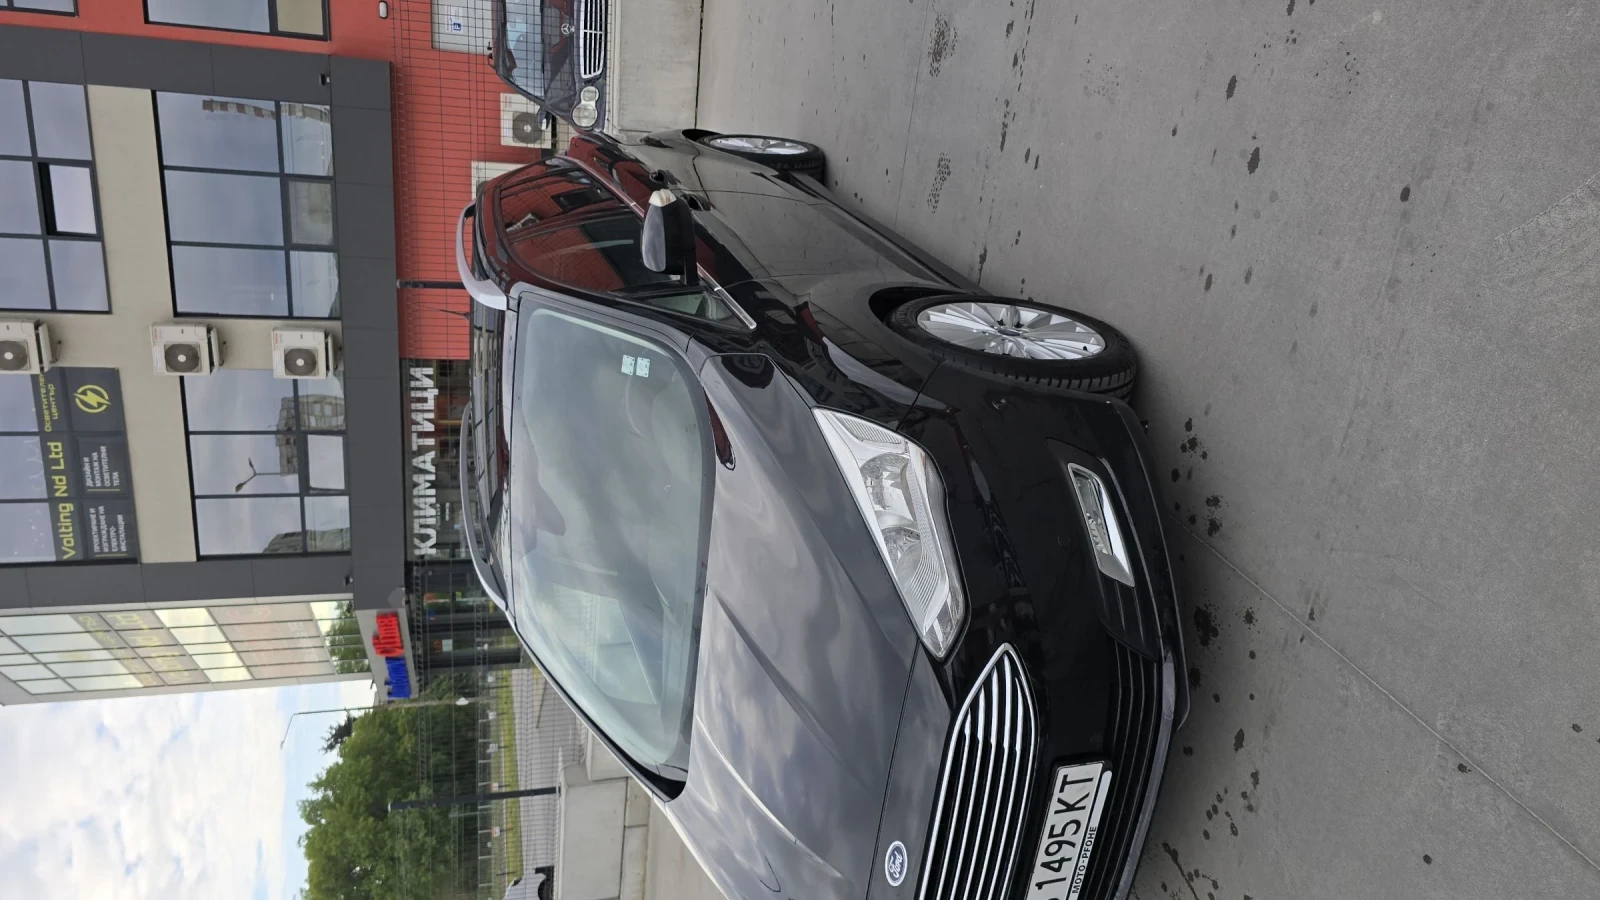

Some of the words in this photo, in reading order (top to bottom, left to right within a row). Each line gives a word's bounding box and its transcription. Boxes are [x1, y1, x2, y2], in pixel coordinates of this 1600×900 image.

[48, 384, 59, 420] център
[48, 442, 64, 469] Ltd
[410, 367, 438, 555] КЛИМАТИЦИ
[52, 475, 68, 497] Nd
[93, 461, 101, 486] МОНТАЖ
[58, 503, 76, 559] Volting
[372, 614, 404, 657] Clima
[889, 850, 903, 878] Ford
